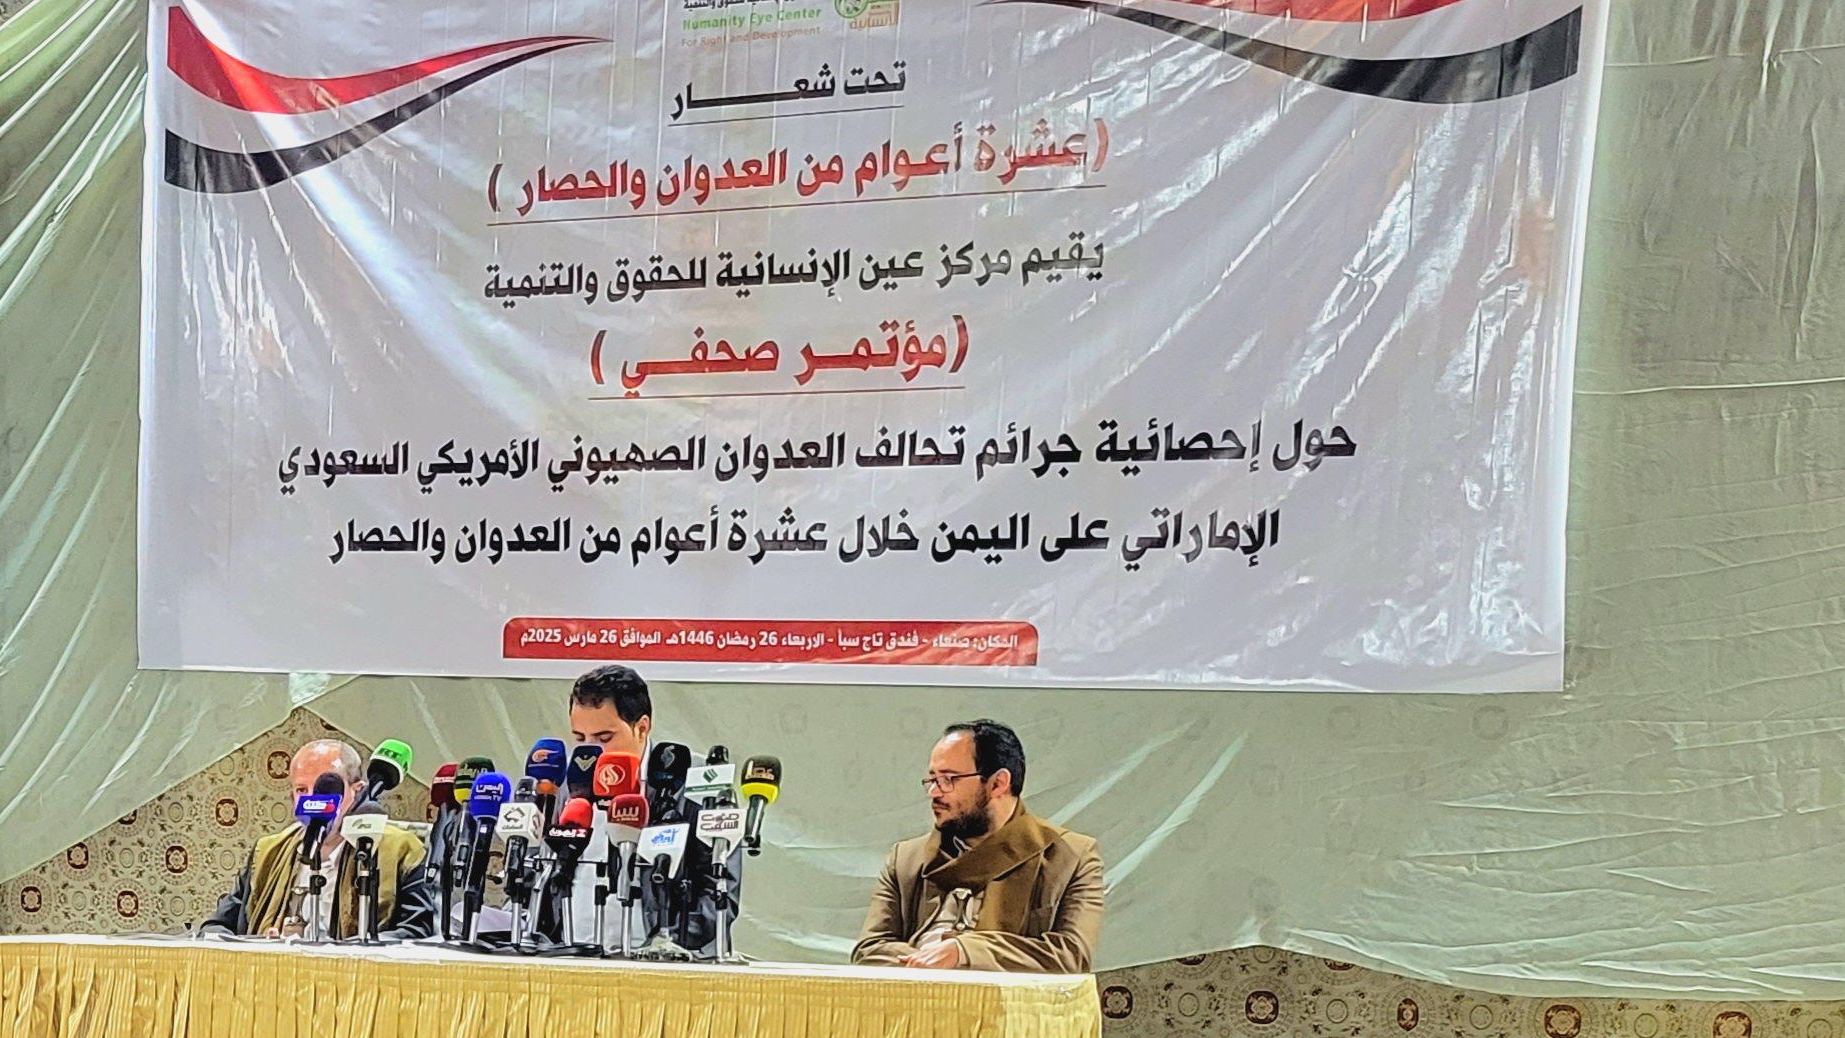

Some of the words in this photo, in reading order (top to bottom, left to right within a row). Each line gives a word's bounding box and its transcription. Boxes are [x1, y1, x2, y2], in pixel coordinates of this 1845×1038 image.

[682, 14, 746, 31] Humanity
[750, 12, 773, 25] Eye
[778, 7, 822, 21] Center
[752, 26, 821, 41] Deveopment
[844, 60, 907, 98] تحت
[656, 147, 788, 205] العدوان
[797, 150, 843, 196] من
[855, 122, 965, 196] أعوام
[516, 160, 646, 215] والحصار
[606, 258, 707, 303] للحقوق
[717, 247, 851, 303] الإنسانية
[859, 247, 924, 292] عين
[936, 238, 1013, 285] مركز
[1021, 230, 1105, 287] يقيم
[483, 262, 599, 309] والتنمية
[278, 440, 410, 495] السعودي
[416, 437, 539, 495] الأمريكي
[547, 434, 706, 493] الصهيوني
[715, 432, 845, 483] العدوان
[855, 424, 966, 470] تحالف
[975, 421, 1083, 482] جرائم
[1094, 419, 1263, 478] إحصائية
[1271, 418, 1358, 472] حول
[328, 517, 445, 565] والحصار
[454, 516, 571, 565] العدوان
[579, 524, 621, 563] من
[630, 504, 718, 569] أعوام
[726, 506, 828, 566] عشرة
[838, 508, 921, 564] خلال
[931, 511, 1031, 565] اليمن
[1040, 512, 1111, 563] على
[1121, 506, 1281, 572] الإماراتي
[564, 629, 597, 648] مارس
[599, 629, 617, 644] 26
[619, 627, 661, 648] الموافق
[716, 630, 757, 649] رمضان
[759, 631, 778, 646] 26
[837, 627, 860, 648] سبأ
[862, 633, 883, 652] تاج
[886, 630, 918, 651] فندق
[931, 632, 971, 649] صنعاء
[377, 748, 403, 760] RT
